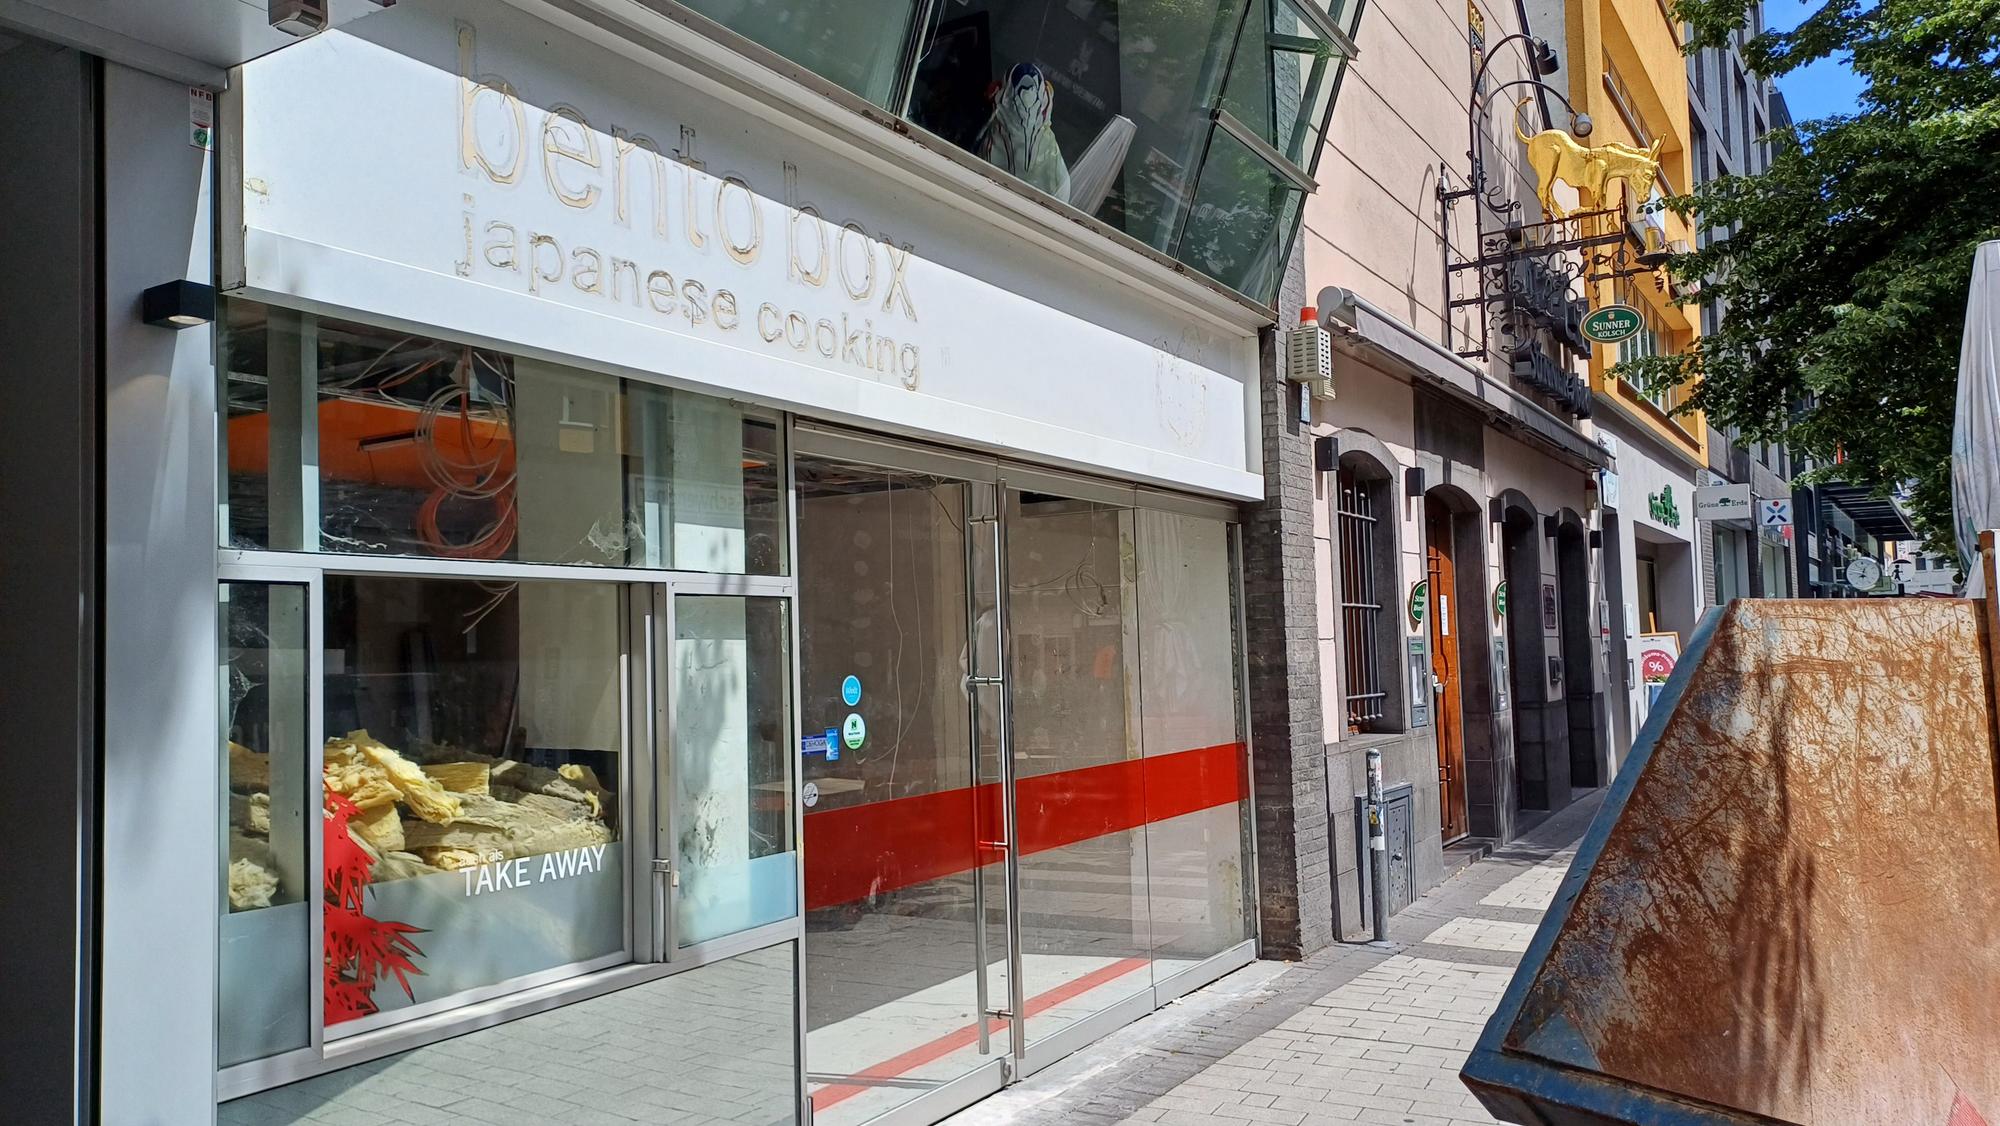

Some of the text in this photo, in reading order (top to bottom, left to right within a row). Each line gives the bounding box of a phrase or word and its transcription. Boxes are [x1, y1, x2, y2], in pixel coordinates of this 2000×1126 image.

[456, 18, 919, 325] bento box
[454, 192, 921, 392] japanese cooking
[459, 843, 607, 896] TAKE AWAY
[488, 848, 504, 862] als
